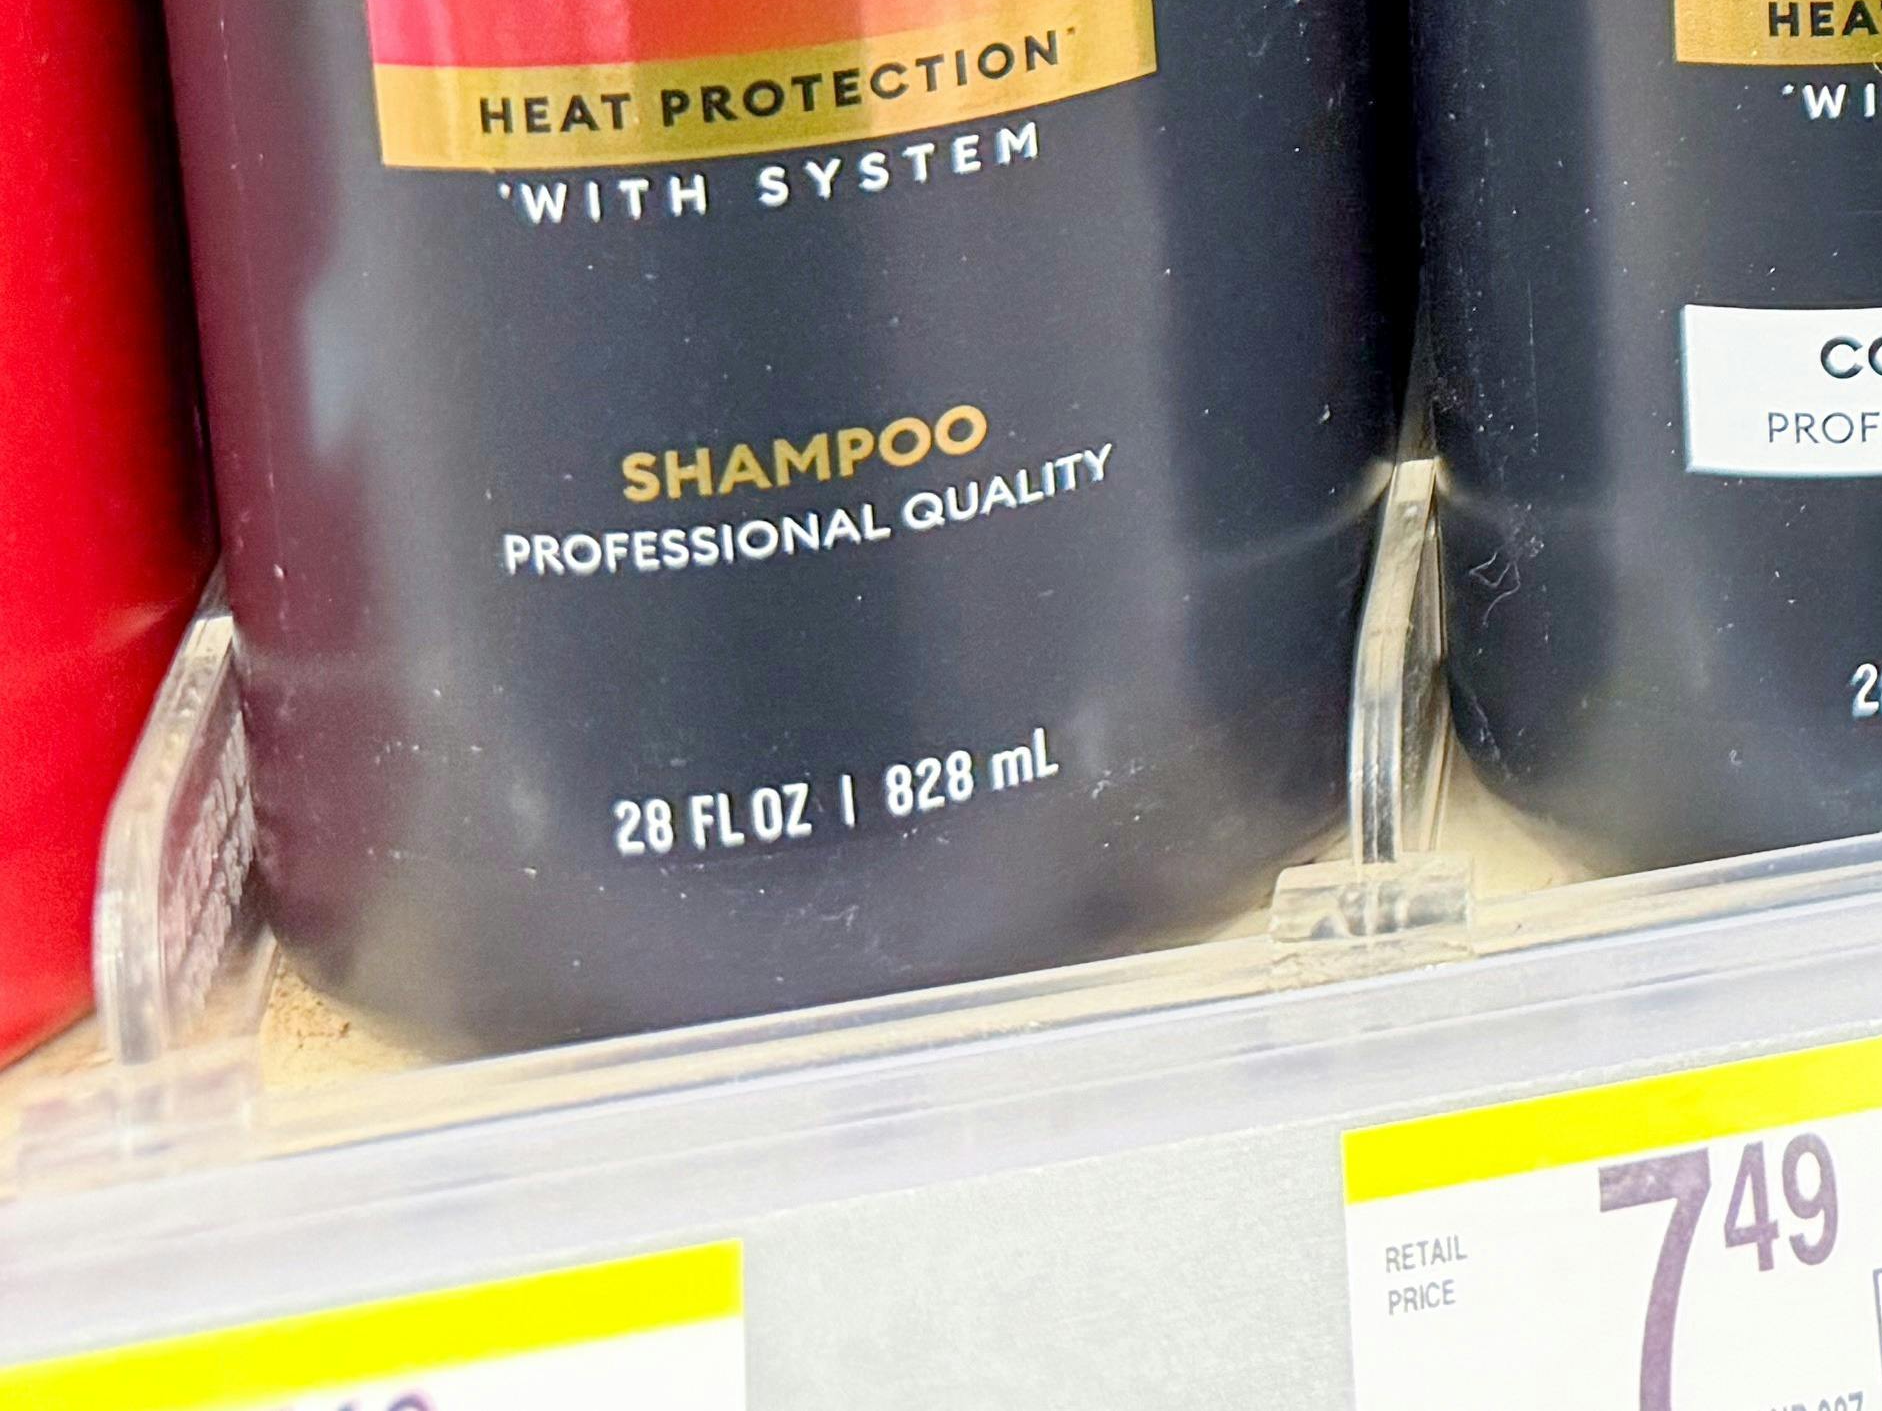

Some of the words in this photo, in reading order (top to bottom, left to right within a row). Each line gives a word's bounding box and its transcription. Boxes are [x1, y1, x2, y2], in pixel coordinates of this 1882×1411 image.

[480, 93, 630, 135] HEAT
[758, 121, 1040, 208] SYSTEM
[621, 405, 988, 502] SHAMPOO
[503, 503, 891, 576] PROFESSIONAL
[902, 443, 1114, 530] QUALITY
[613, 801, 673, 856] 28
[885, 749, 974, 817] 828
[992, 727, 1060, 790] mL
[1385, 1235, 1467, 1273] RETAIL
[1387, 1281, 1457, 1316] PRICE
